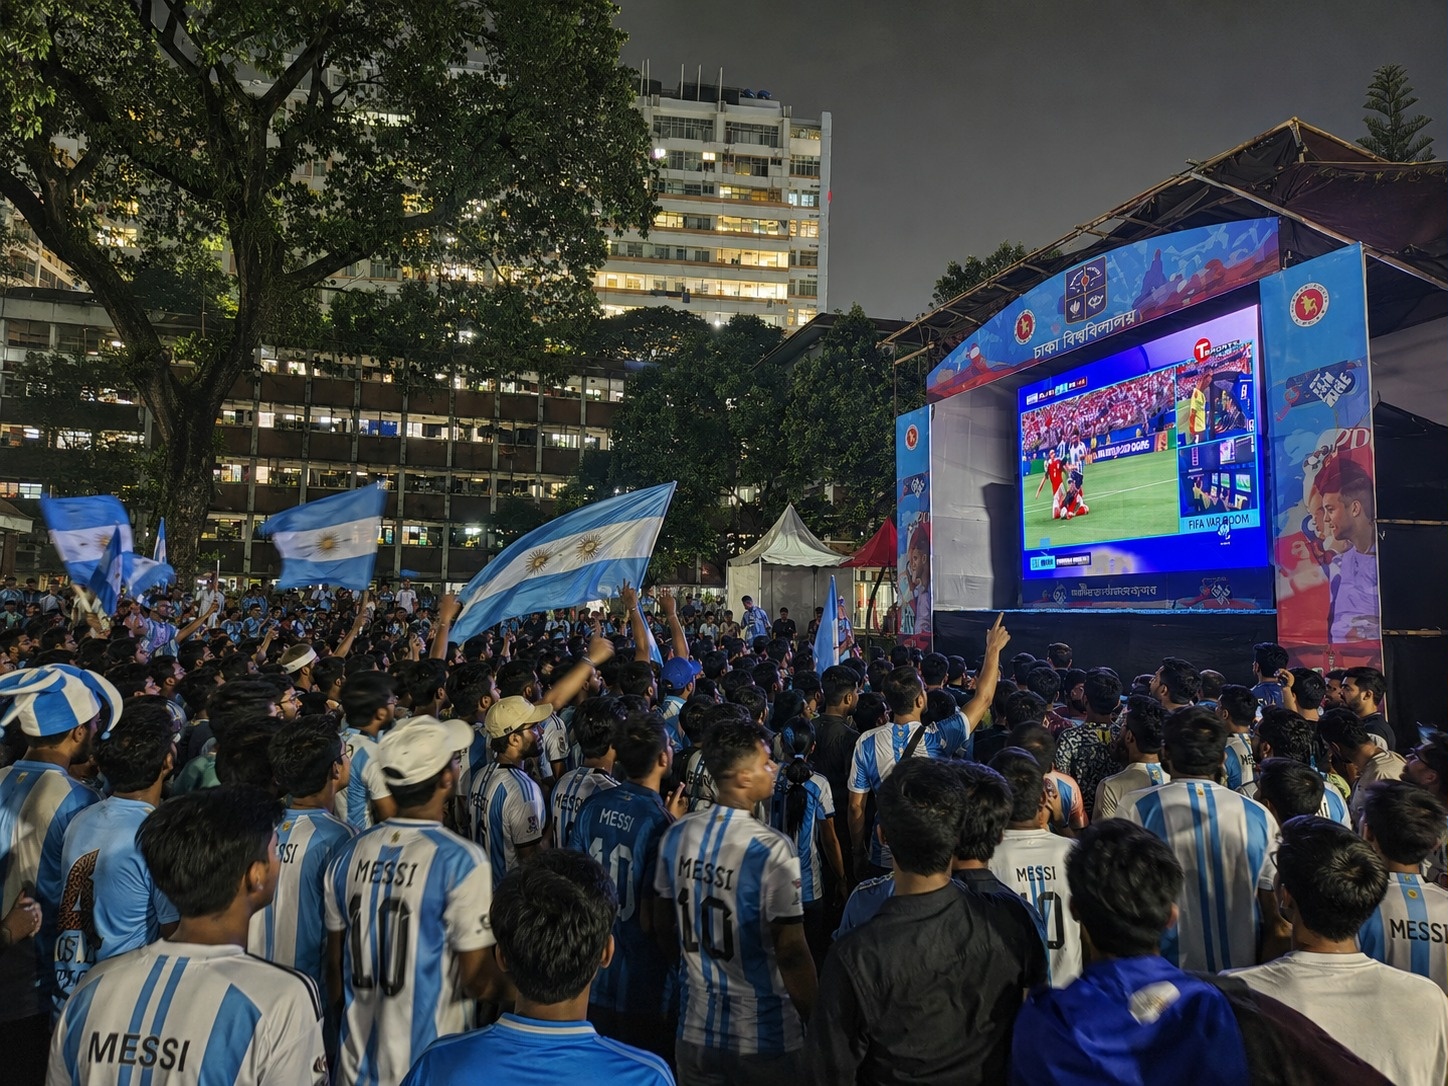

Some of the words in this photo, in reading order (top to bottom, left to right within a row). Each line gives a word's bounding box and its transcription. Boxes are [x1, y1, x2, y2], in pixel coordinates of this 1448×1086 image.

[1188, 519, 1205, 531] FIFA
[599, 808, 635, 833] MESSI
[354, 858, 418, 888] MESSI
[678, 855, 734, 891] MESSI
[1016, 865, 1057, 882] MESSI
[677, 887, 734, 962] 10
[1389, 918, 1448, 944] MESSI
[349, 893, 411, 997] 10
[88, 1031, 190, 1072] MESSI
